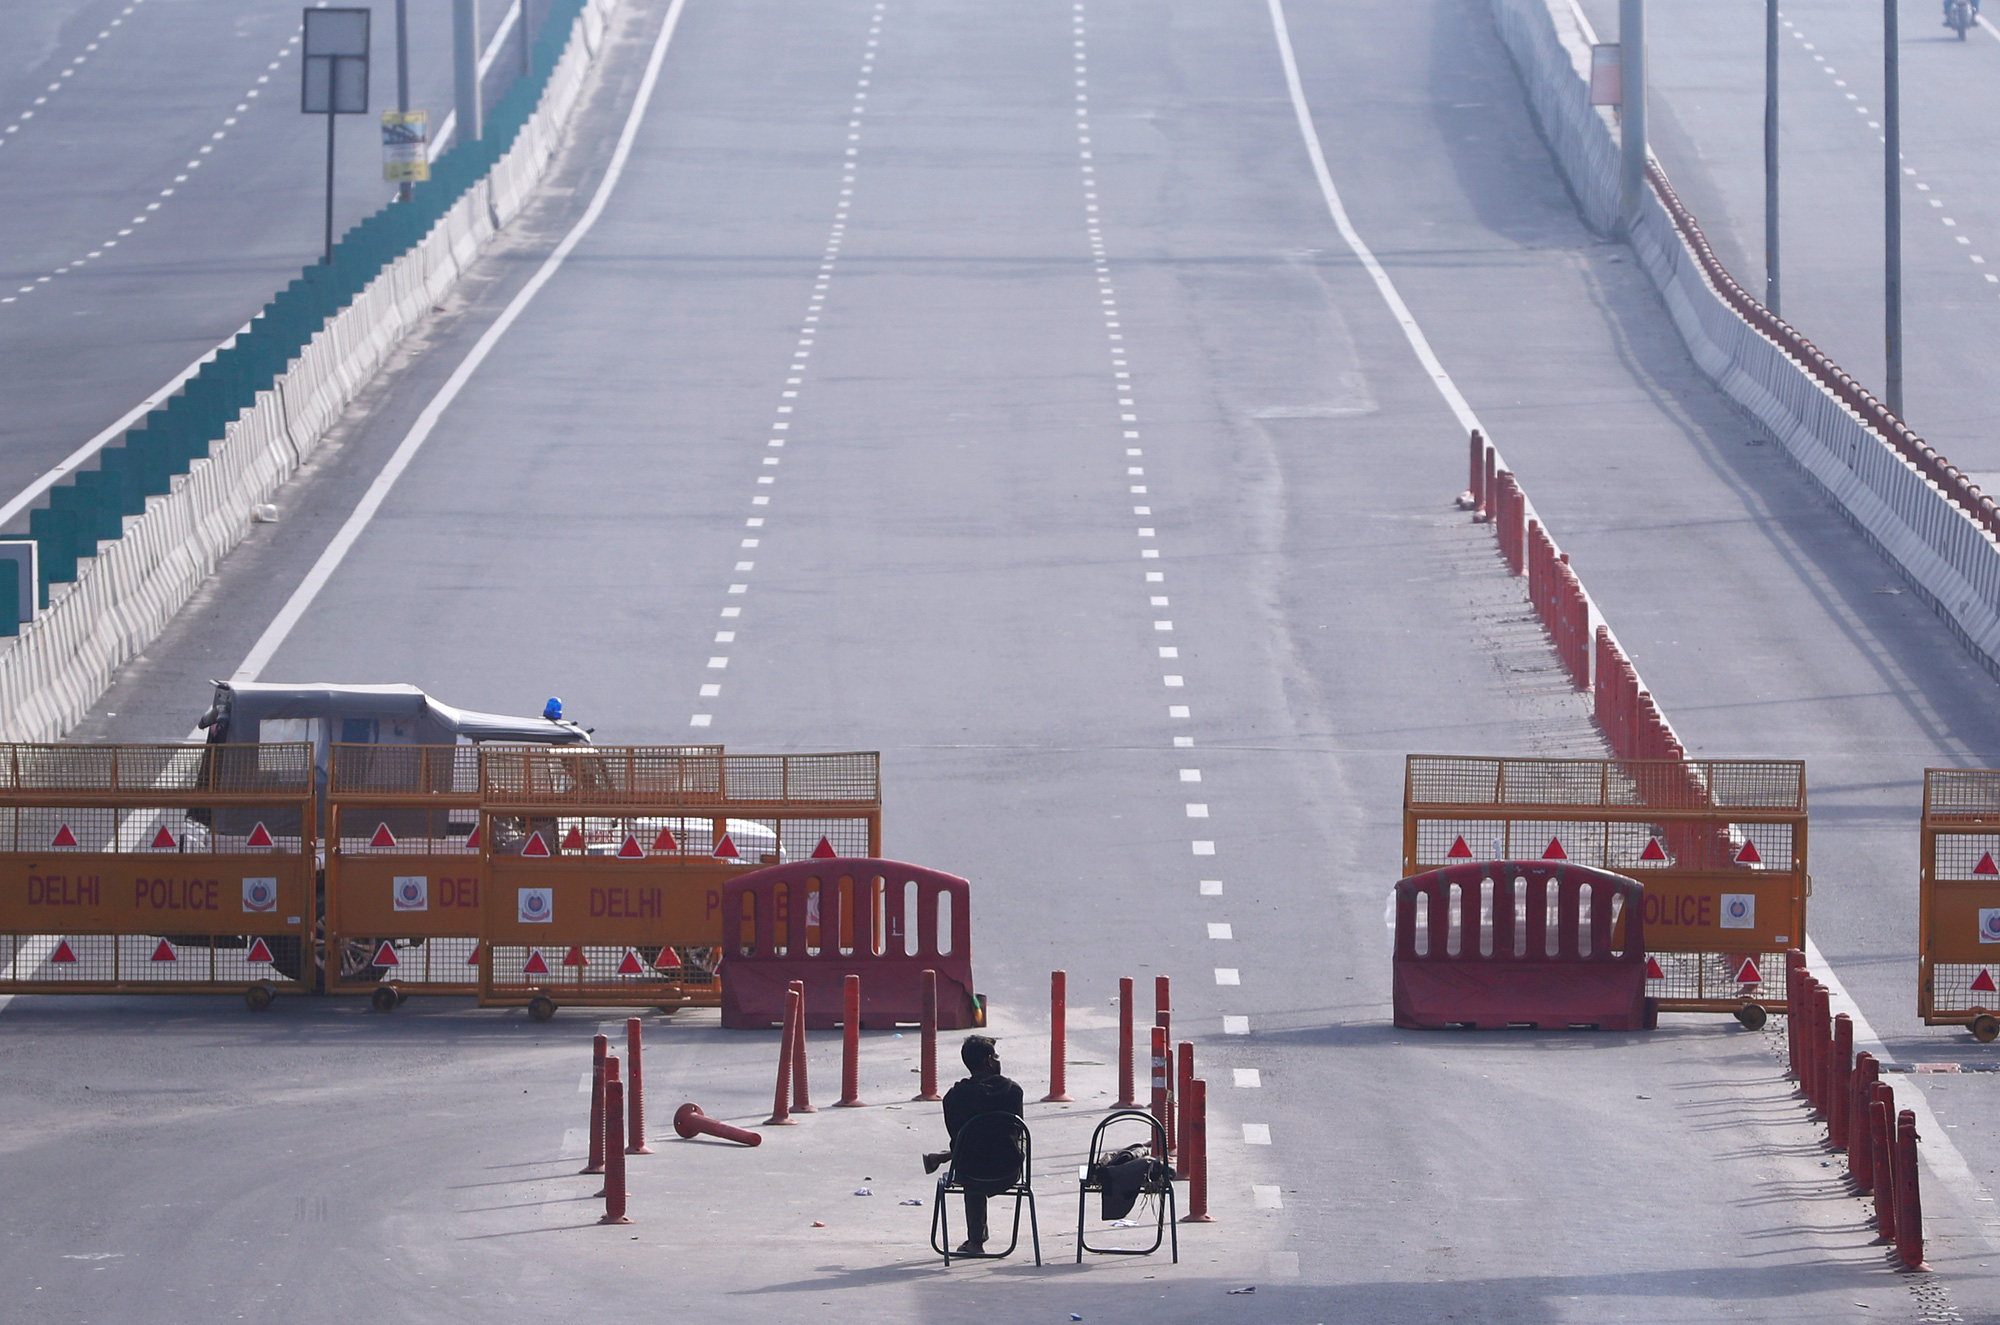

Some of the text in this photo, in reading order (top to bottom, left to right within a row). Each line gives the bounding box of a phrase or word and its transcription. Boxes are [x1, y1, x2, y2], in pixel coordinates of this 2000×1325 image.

[28, 876, 219, 910] DELHI POLICE
[440, 878, 479, 907] DEL
[590, 887, 661, 918] DELHI
[1643, 894, 1711, 926] OLICE
